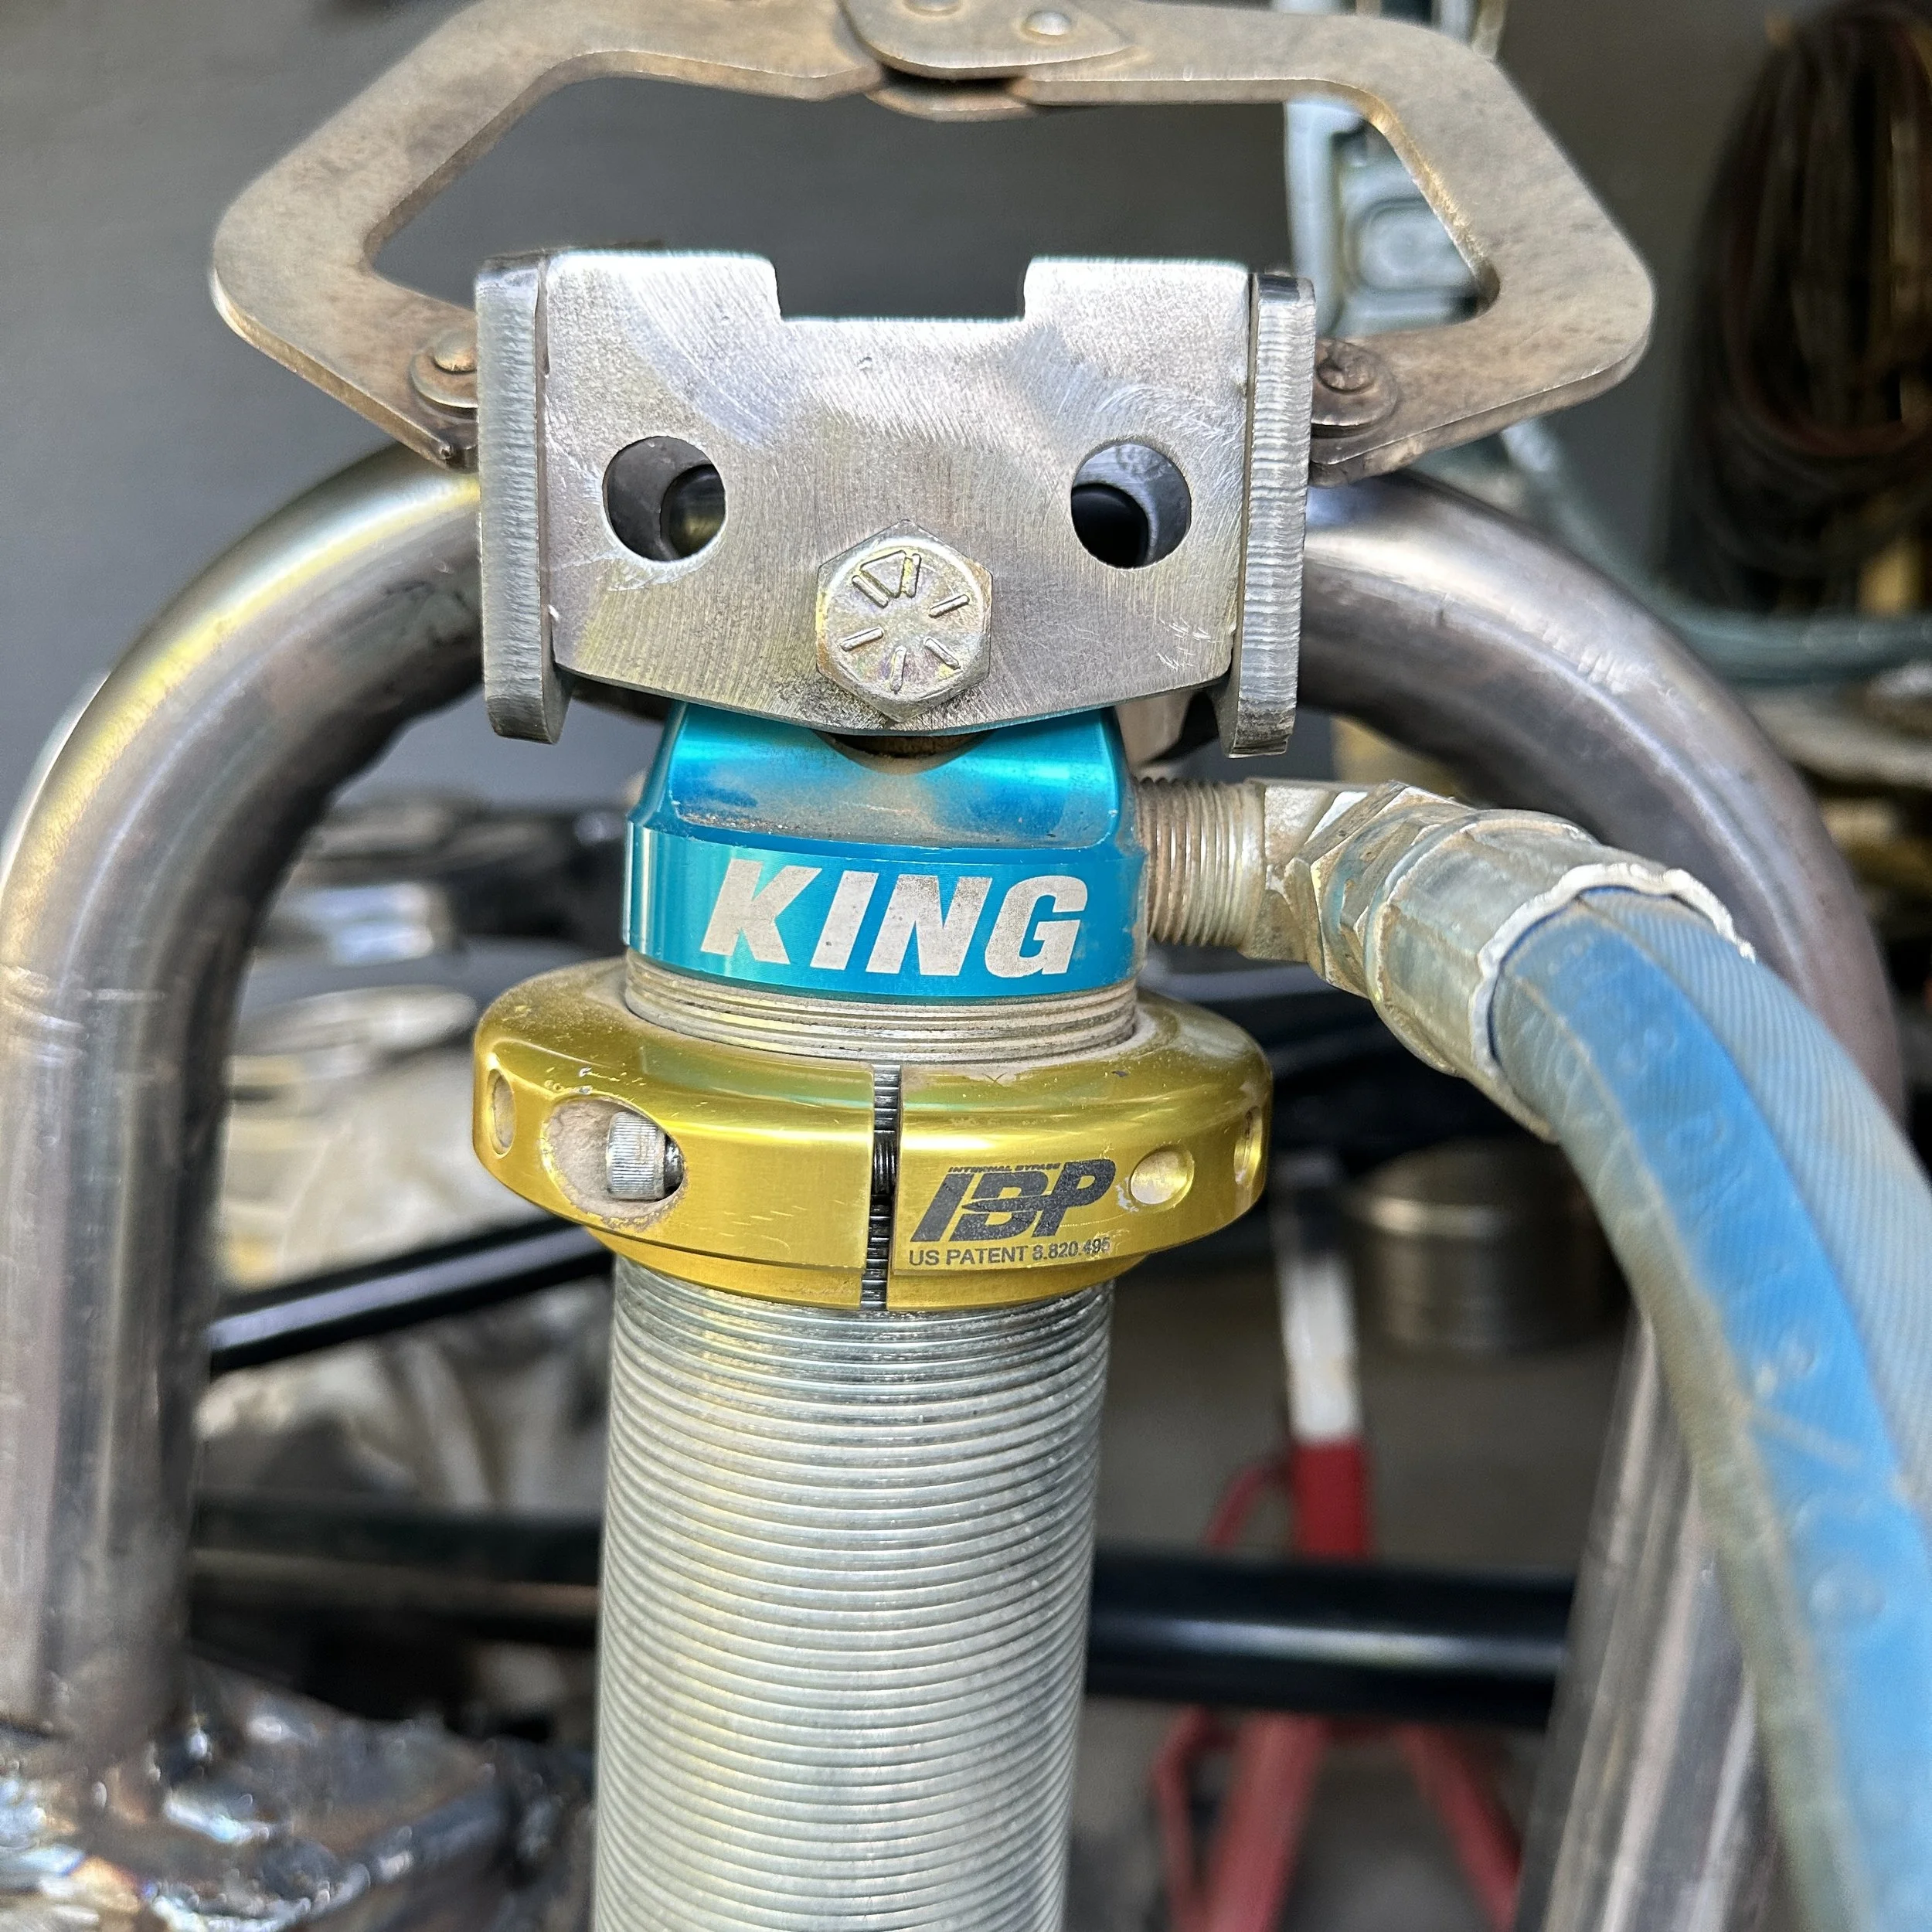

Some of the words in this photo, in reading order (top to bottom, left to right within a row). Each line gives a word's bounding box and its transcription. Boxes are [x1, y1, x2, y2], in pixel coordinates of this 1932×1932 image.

[700, 858, 1088, 978] KING
[910, 1158, 1116, 1242] IBP
[909, 1249, 940, 1266] US
[946, 1245, 1029, 1266] PATENT
